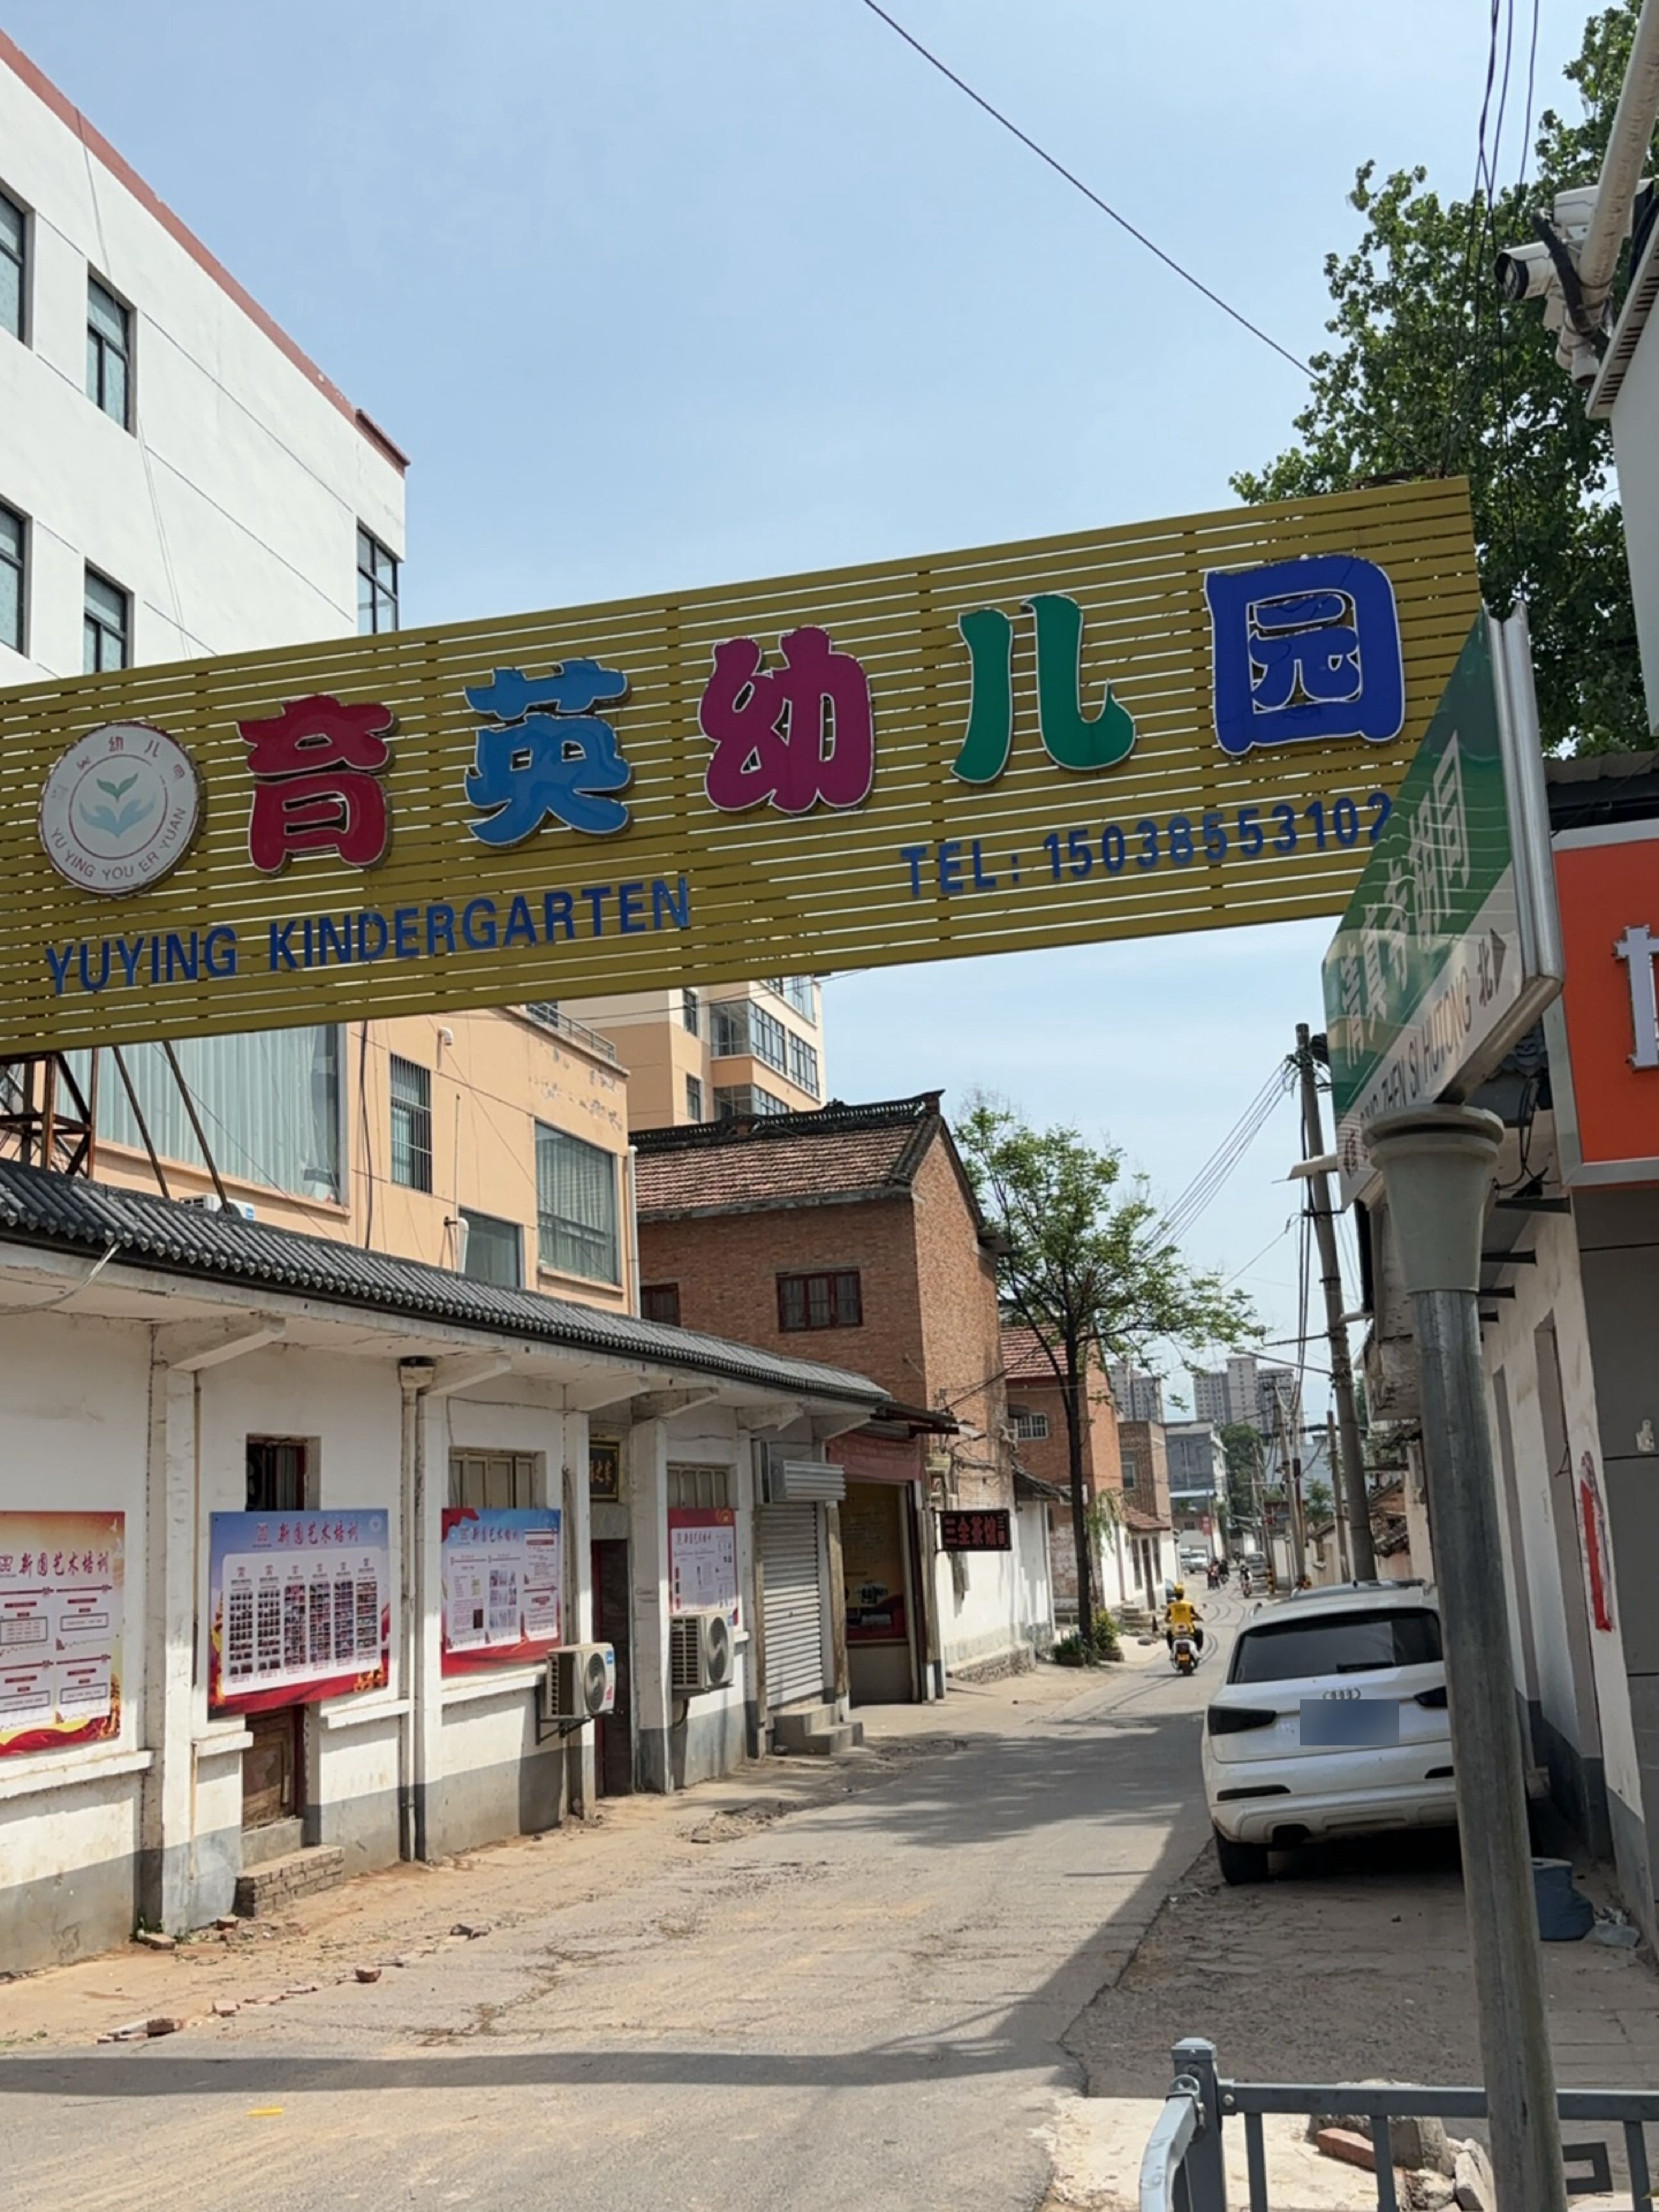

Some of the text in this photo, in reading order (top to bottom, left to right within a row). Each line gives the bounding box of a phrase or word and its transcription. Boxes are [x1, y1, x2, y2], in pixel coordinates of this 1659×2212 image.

[236, 554, 1405, 875] 育英幼儿园
[51, 807, 187, 881] YU YING YOU ER YUAN
[1043, 791, 1393, 880] 15038553102
[45, 876, 689, 995] YUYING KINDERGARTEN
[1341, 730, 1470, 1070] 清真寺胡同
[1420, 966, 1472, 1084] HUTONG
[1479, 938, 1493, 1007] 北
